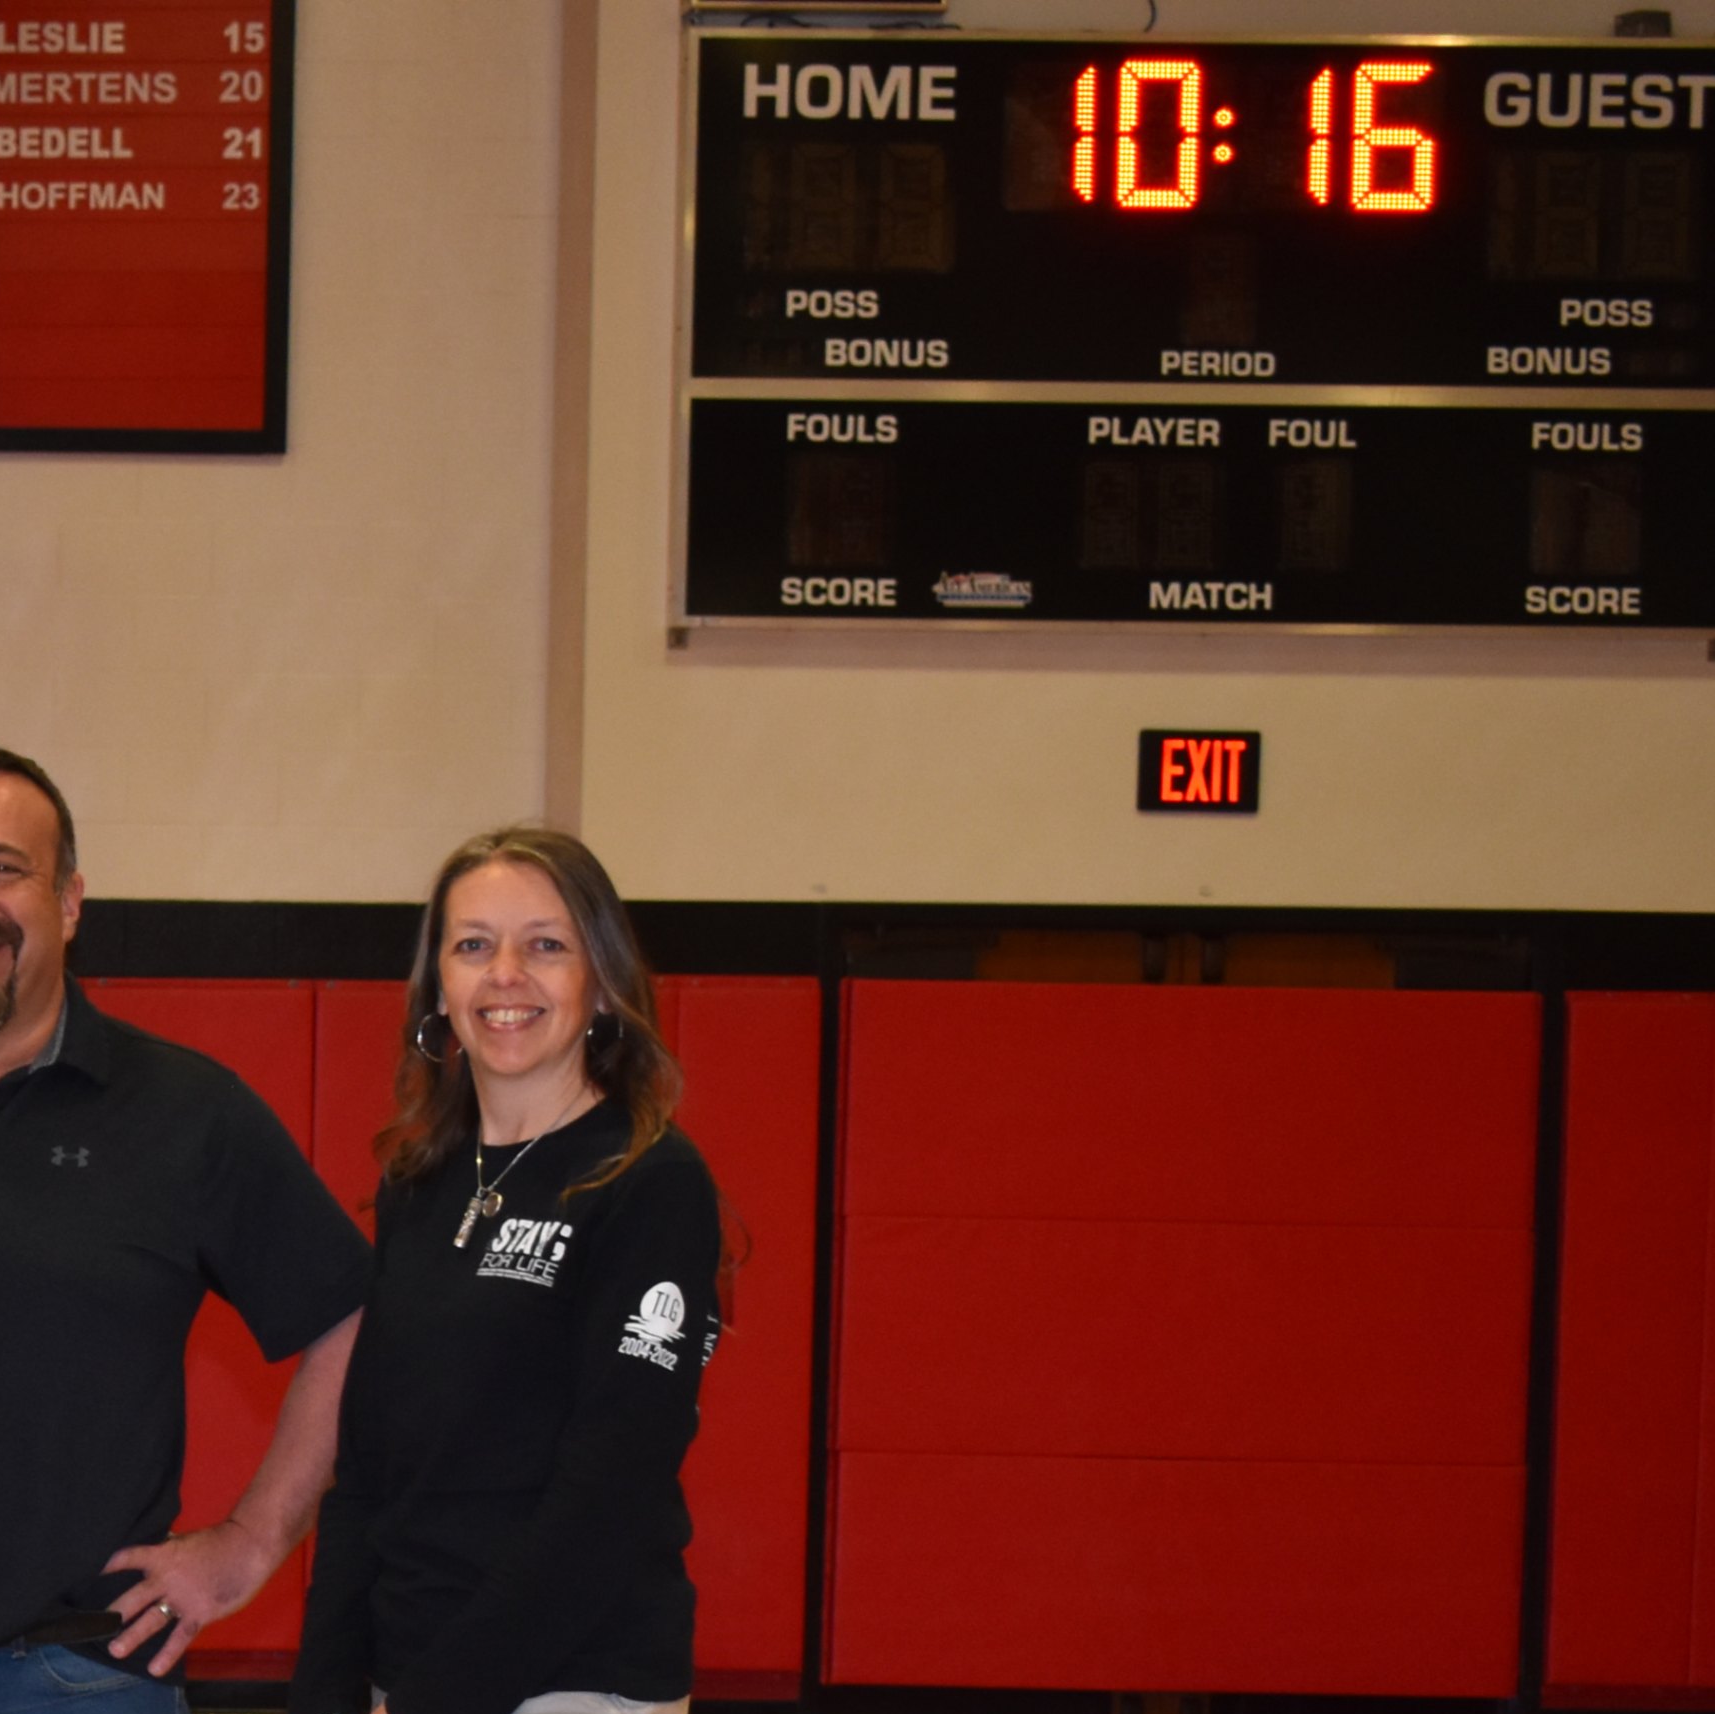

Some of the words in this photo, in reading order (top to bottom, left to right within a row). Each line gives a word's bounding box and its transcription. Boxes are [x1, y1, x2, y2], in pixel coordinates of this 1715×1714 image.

[223, 22, 265, 54] 15
[219, 71, 264, 103] 20
[743, 64, 957, 122] HOME
[1483, 72, 1715, 131] GUEST
[222, 128, 263, 159] 21
[1074, 60, 1435, 211] 10:16
[222, 184, 260, 211] 23
[785, 289, 879, 320] POSS
[1559, 299, 1654, 329] POSS
[823, 339, 949, 368] BONUS
[1160, 350, 1276, 378] PERIOD
[1486, 348, 1611, 376] BONUS
[786, 414, 898, 443] FOULS
[1087, 417, 1221, 449] PLAYER
[1268, 419, 1357, 449] FOUL
[1531, 423, 1644, 452] FOULS
[781, 577, 897, 606] SCORE
[1149, 581, 1273, 612] MATCH
[1525, 586, 1642, 616] SCORE
[1161, 740, 1246, 802] EXIT
[491, 1218, 573, 1261] STAY;
[480, 1253, 513, 1268] FOR
[515, 1255, 559, 1280] LIFE
[652, 1291, 681, 1323] TLG
[617, 1336, 678, 1371] 2004-2022
